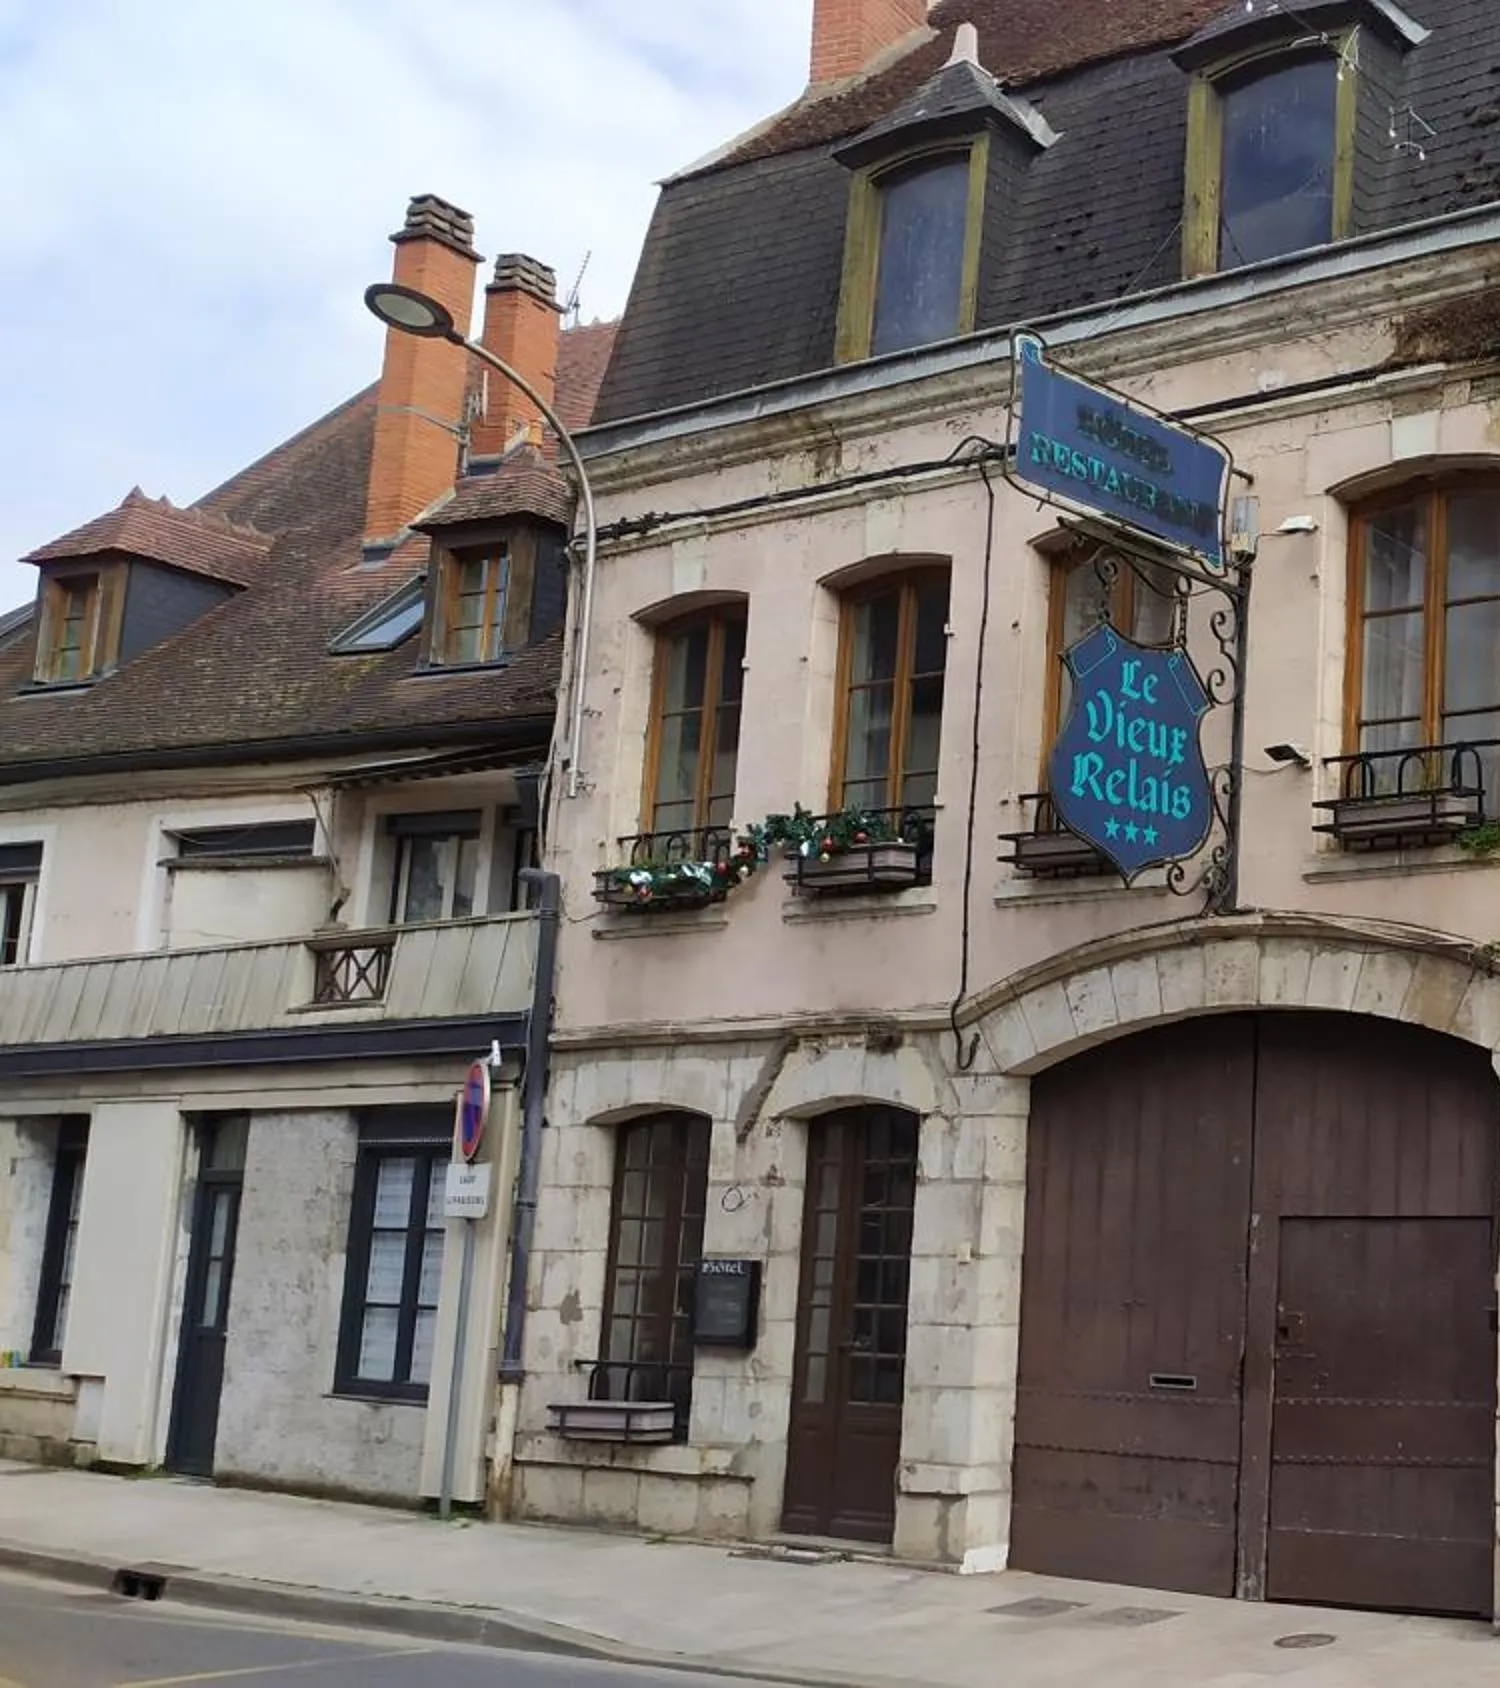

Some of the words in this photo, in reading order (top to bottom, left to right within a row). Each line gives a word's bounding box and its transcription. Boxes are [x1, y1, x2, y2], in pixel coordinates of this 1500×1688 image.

[1120, 658, 1159, 705] Le
[1086, 689, 1188, 765] Vieux
[1071, 751, 1192, 820] Relais
